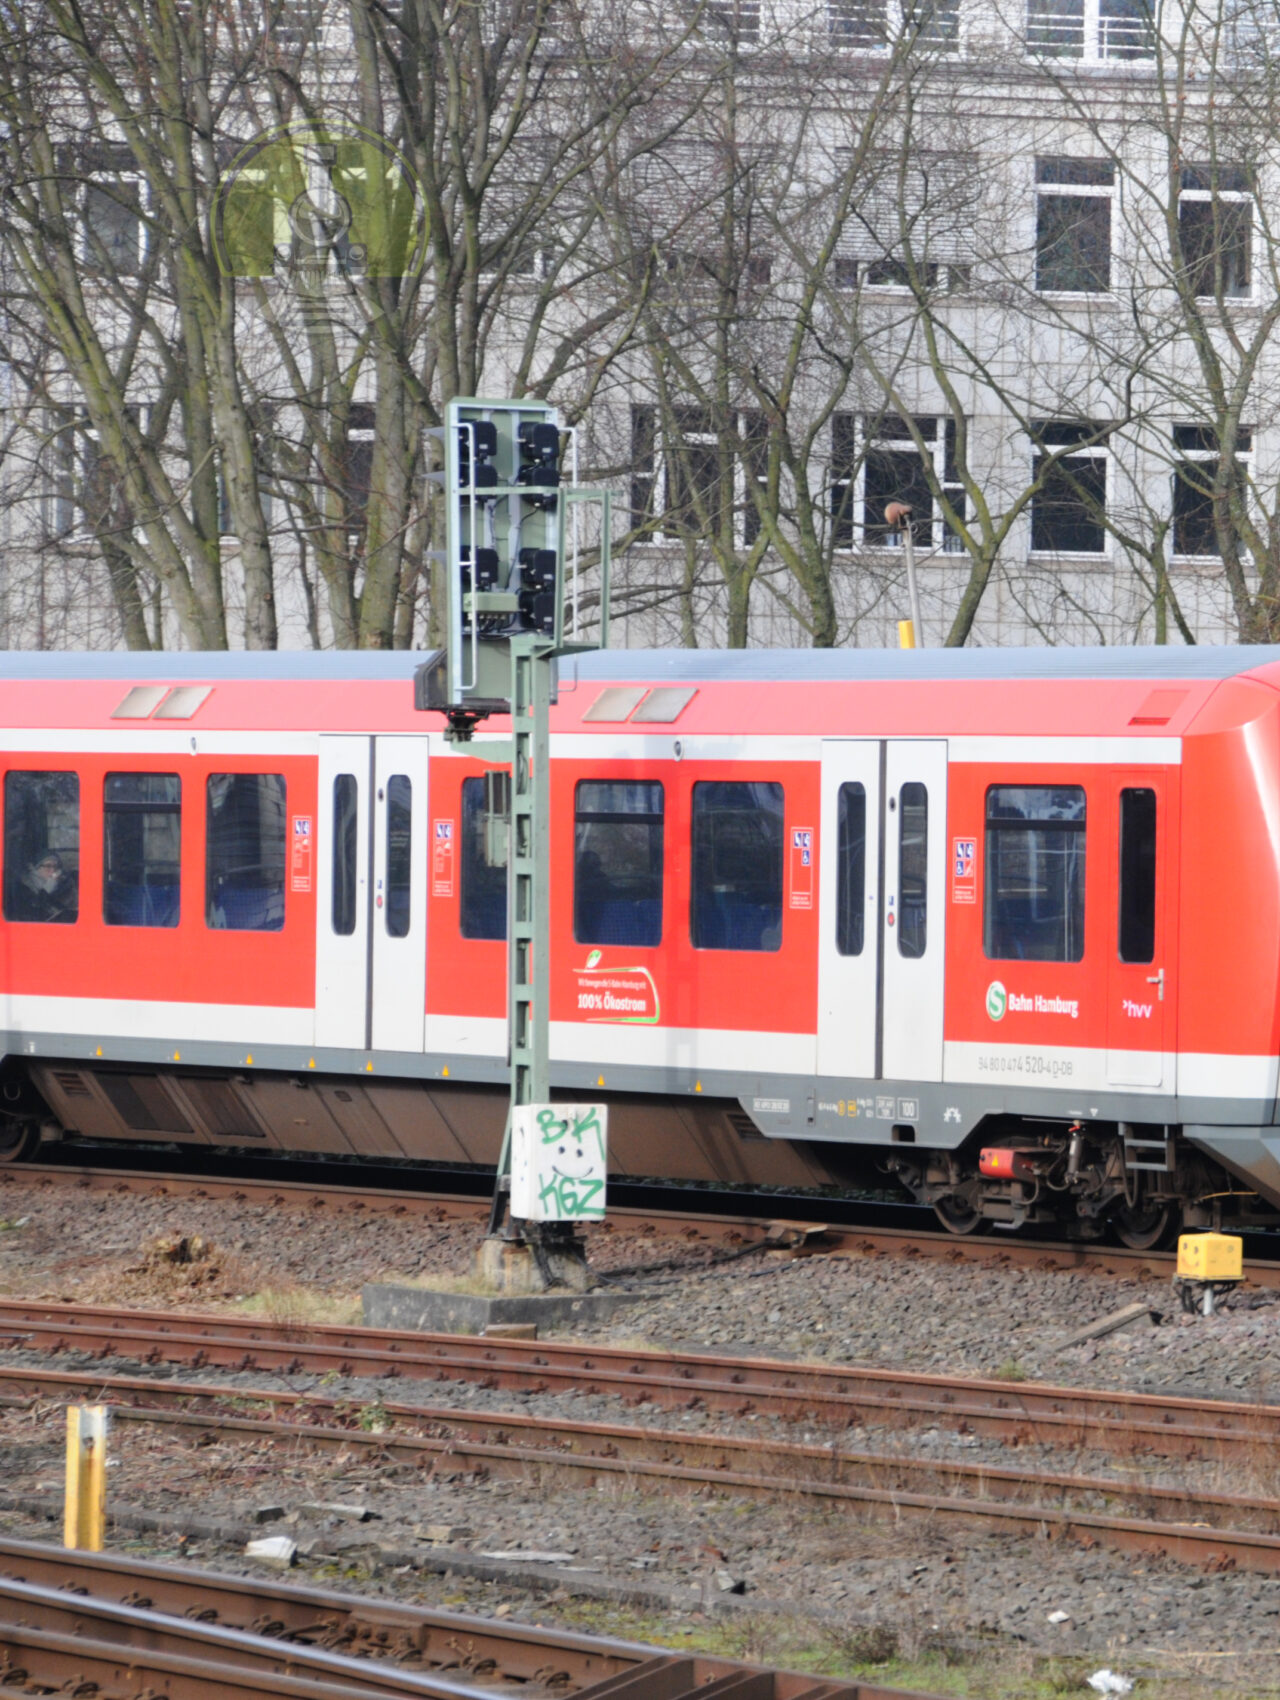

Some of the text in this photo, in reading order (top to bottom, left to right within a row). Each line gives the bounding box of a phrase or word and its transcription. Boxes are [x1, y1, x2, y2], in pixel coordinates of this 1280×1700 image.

[577, 991, 646, 1012] 100% Ökostrom
[987, 983, 1079, 1020] S Bahn Hamburg
[902, 1101, 915, 1117] 100
